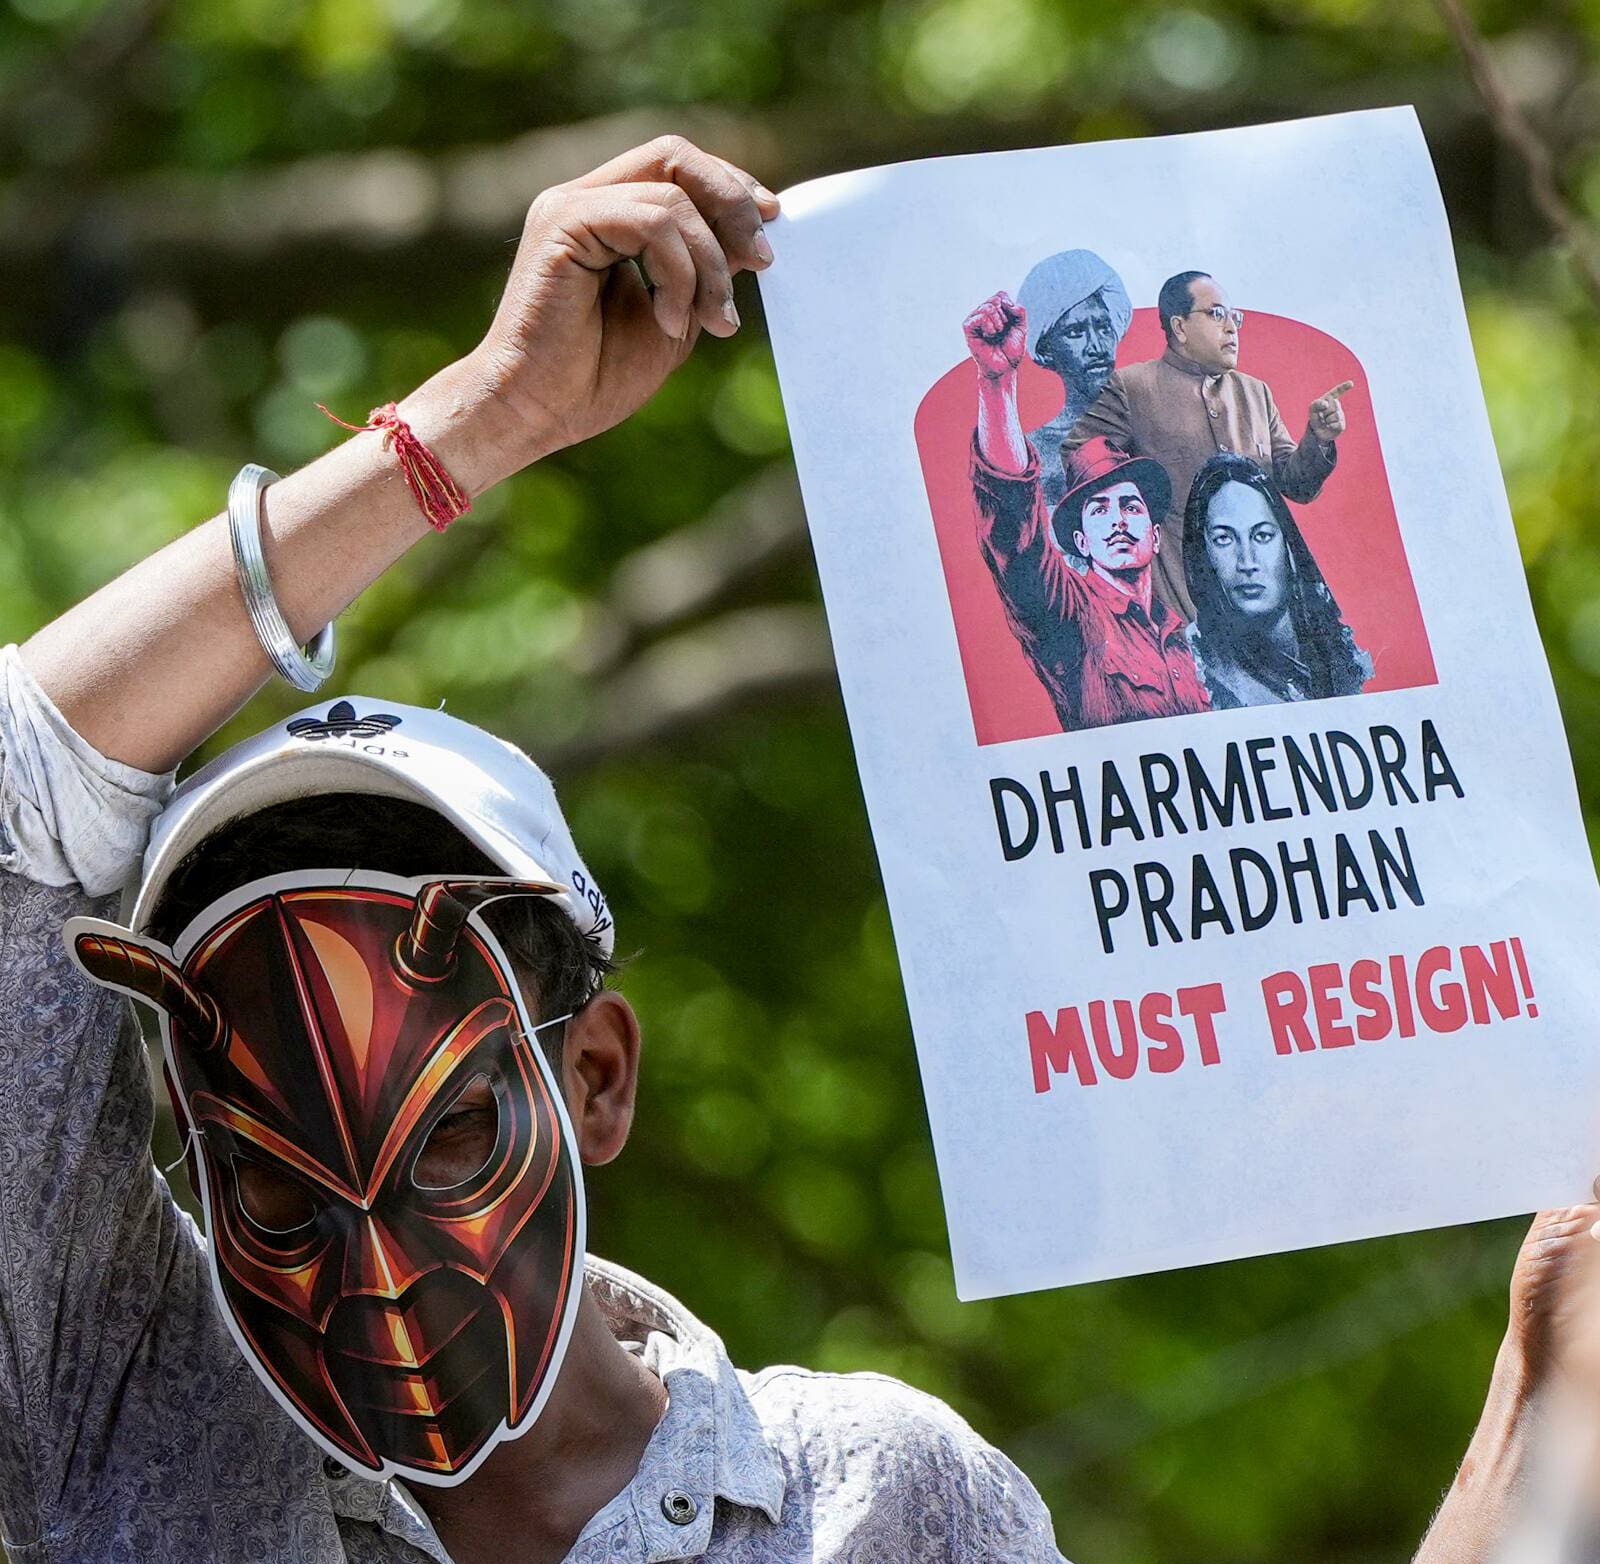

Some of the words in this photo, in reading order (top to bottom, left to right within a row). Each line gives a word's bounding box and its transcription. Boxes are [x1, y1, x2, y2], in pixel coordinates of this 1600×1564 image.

[988, 719, 1466, 862] DHARMENDRA
[1088, 826, 1426, 954] PRADHAN
[1025, 982, 1227, 1094] MUST
[1261, 936, 1539, 1056] RESIGN!
